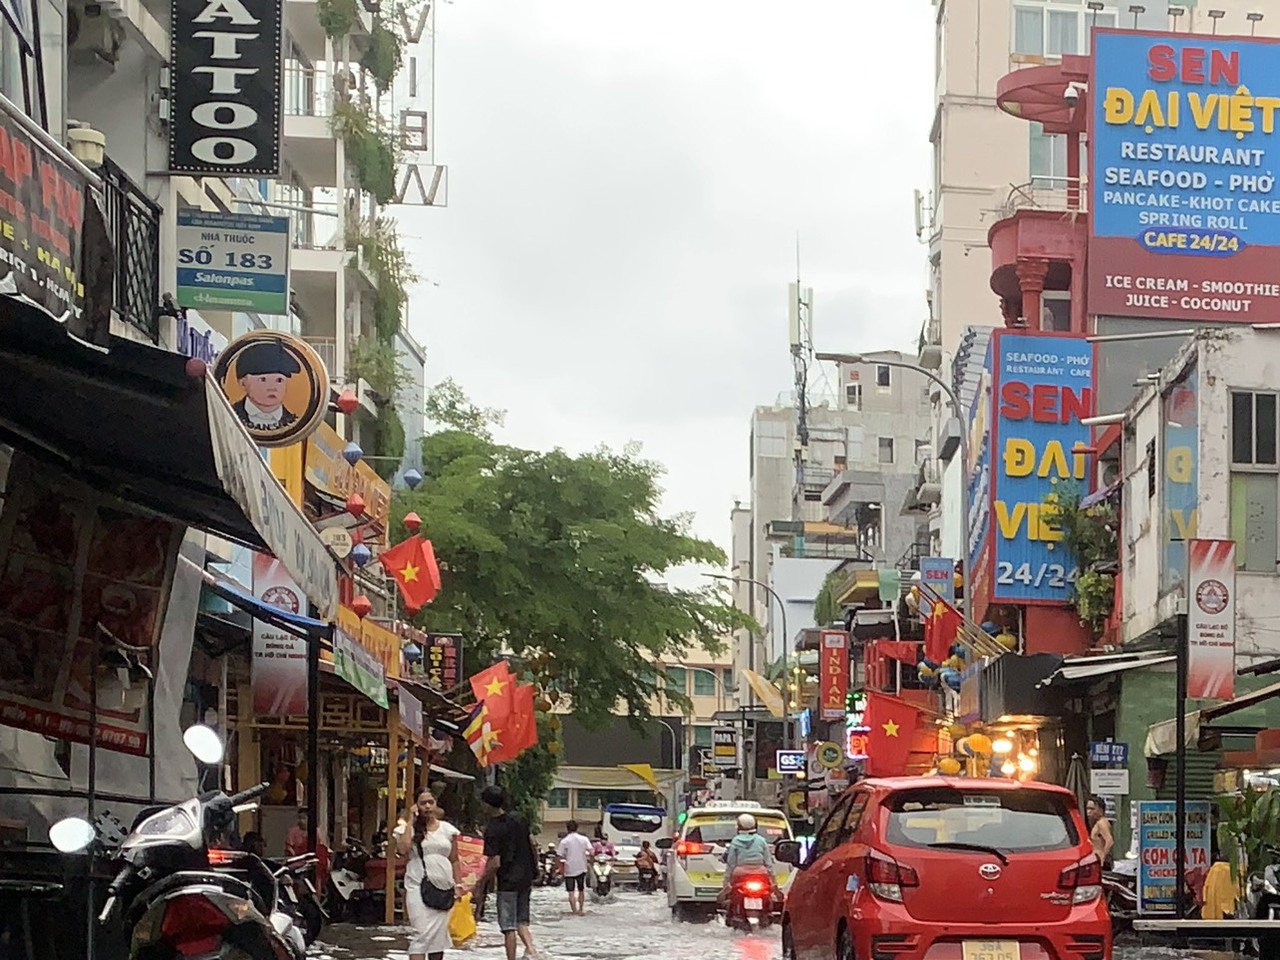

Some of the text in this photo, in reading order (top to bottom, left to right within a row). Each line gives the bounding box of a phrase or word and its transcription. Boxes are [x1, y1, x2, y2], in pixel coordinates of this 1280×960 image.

[1148, 45, 1239, 87] SEN
[1103, 87, 1179, 134] ĐẠI
[1121, 142, 1265, 167] RESTAURANT
[1104, 167, 1207, 190] SEAFOOD
[1229, 170, 1275, 193] PHỞ
[1238, 199, 1280, 214] CAKE
[1139, 212, 1248, 231] SPRING ROLL
[1144, 231, 1239, 252] CAFE 24/24
[178, 244, 272, 269] SỐ 183
[1105, 275, 1132, 290] ICE
[1135, 277, 1188, 293] CREAM
[1201, 280, 1280, 297] SMOOTHIE
[1125, 294, 1169, 308] JUICE
[1180, 296, 1252, 312] COCONUT
[1006, 352, 1058, 364] SEAFOOD
[1066, 354, 1090, 366] PHỞ
[1006, 365, 1091, 377] RESTAURANT CAFE
[1000, 380, 1091, 424] SEN
[1003, 437, 1086, 484] ĐẠI
[993, 493, 1070, 550] VIỆ
[925, 570, 948, 580] SEN
[829, 648, 841, 705] INDIAN
